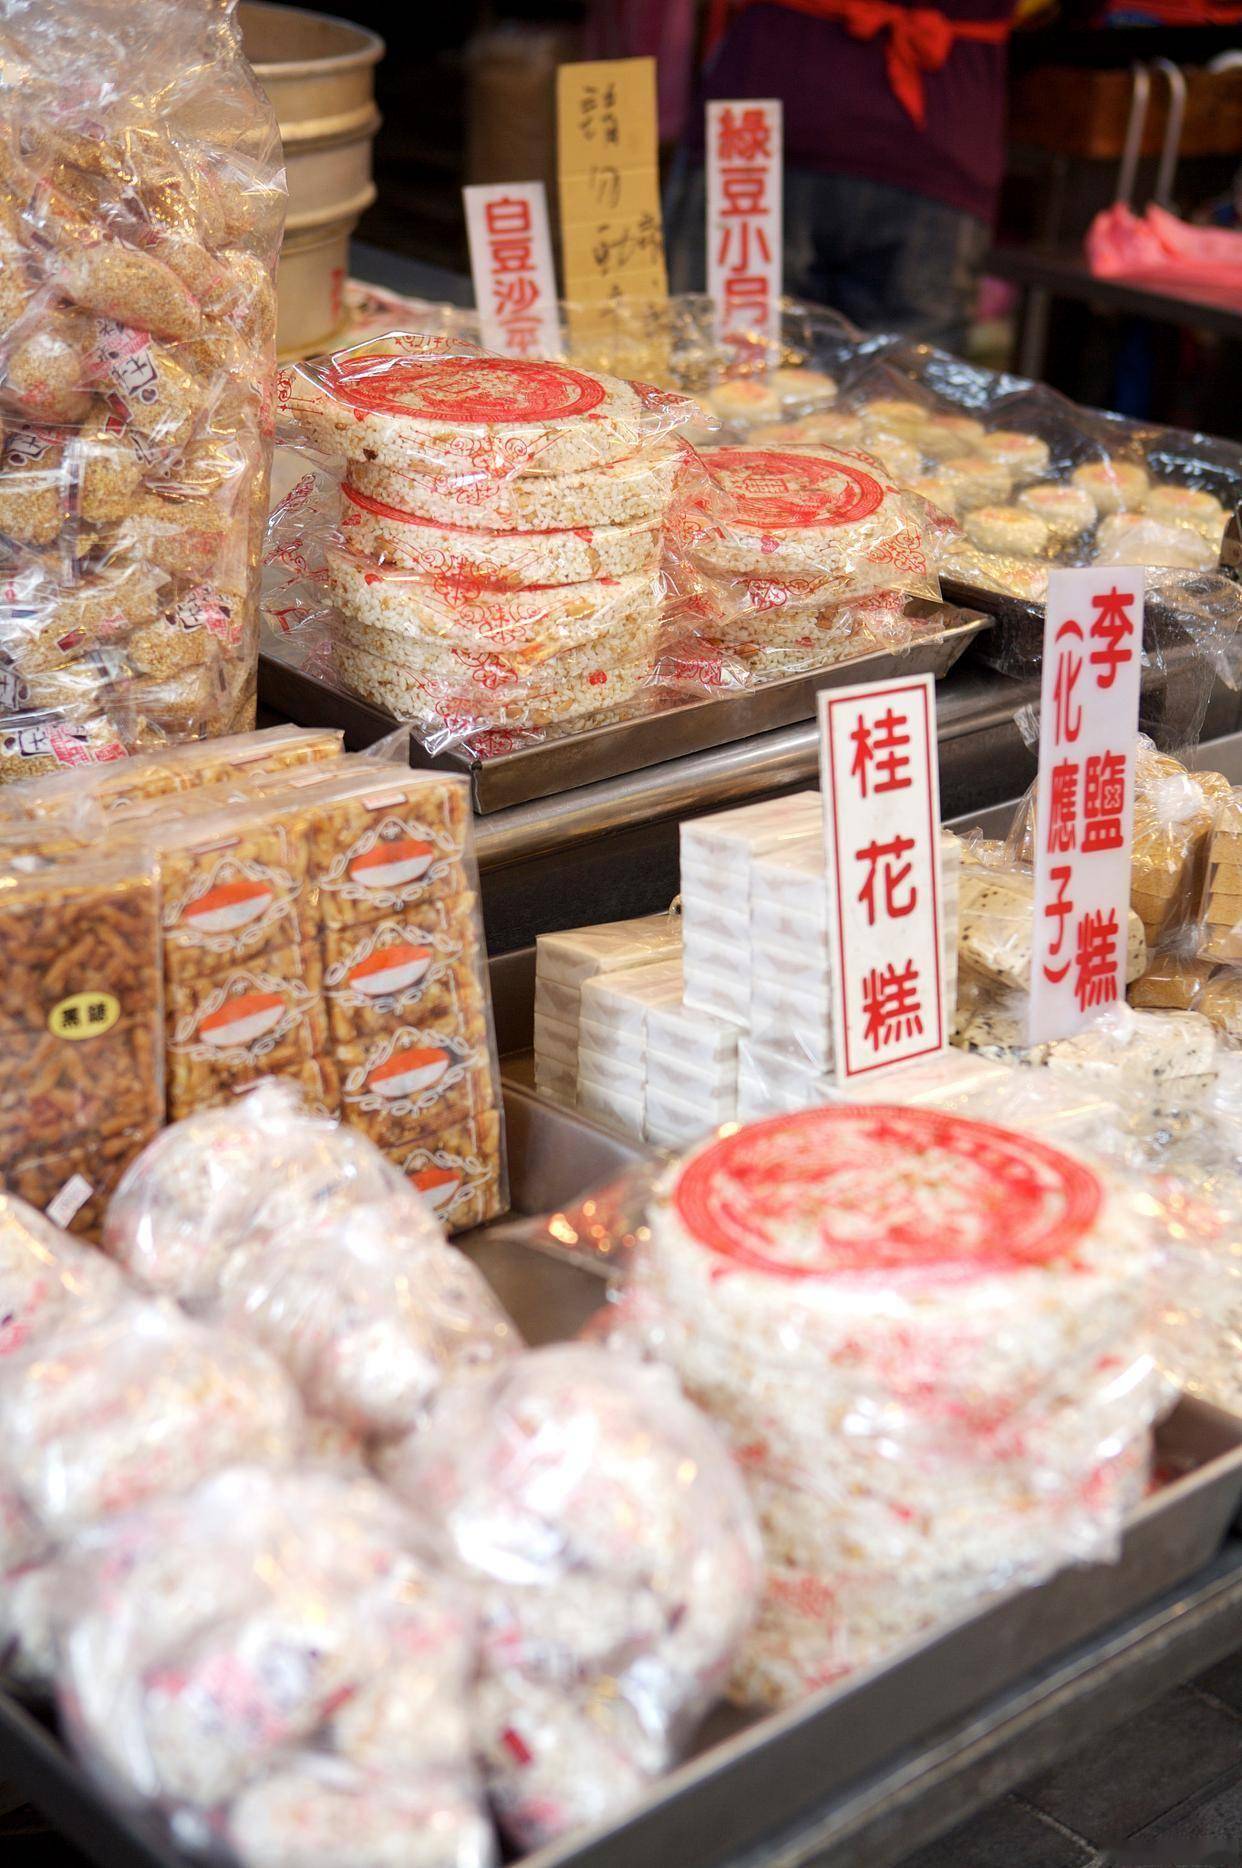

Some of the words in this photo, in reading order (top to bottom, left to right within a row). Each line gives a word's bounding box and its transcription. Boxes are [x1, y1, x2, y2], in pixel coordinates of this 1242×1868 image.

[849, 707, 925, 1052] 桂花糕
[1074, 586, 1134, 1013] 李鹽糕
